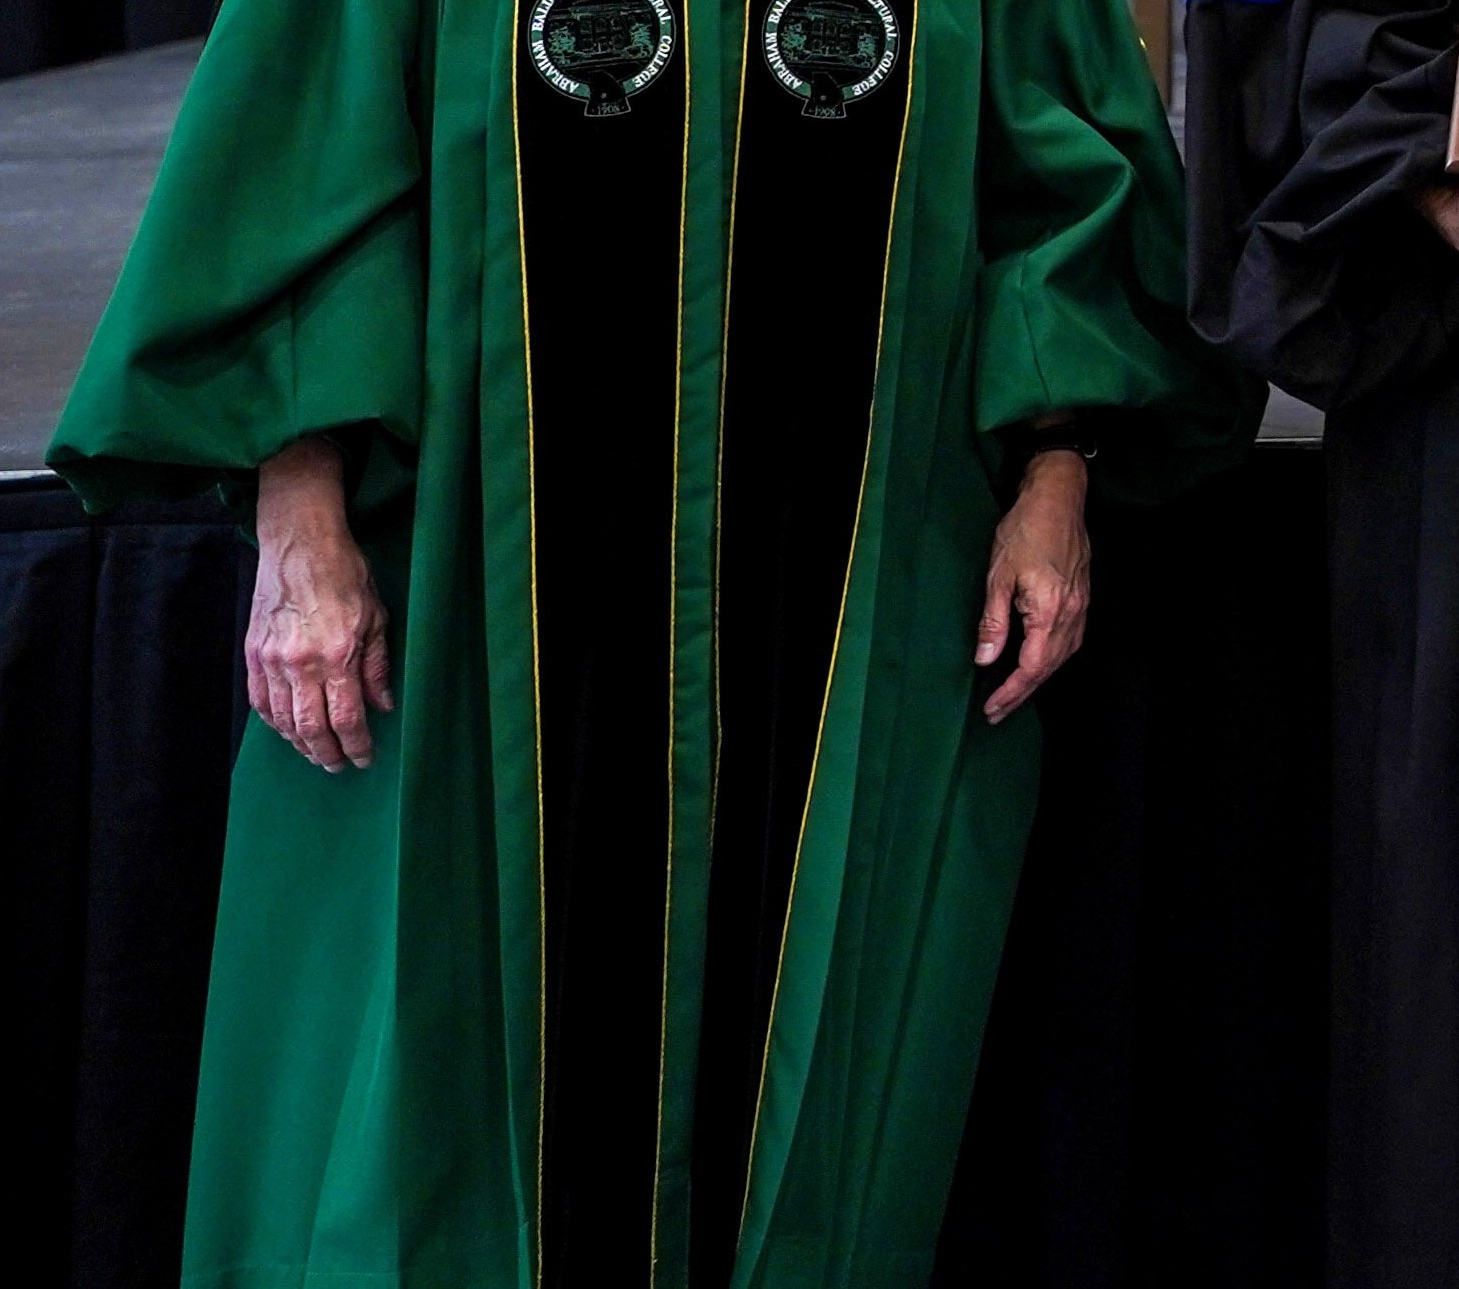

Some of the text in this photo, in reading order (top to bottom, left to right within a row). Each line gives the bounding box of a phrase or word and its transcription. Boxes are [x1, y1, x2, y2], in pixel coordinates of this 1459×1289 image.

[531, 39, 580, 93] ABRAHAM
[632, 35, 673, 88] COLLEGE
[765, 32, 804, 90] ABRAHAM
[851, 50, 895, 96] COLLEGE
